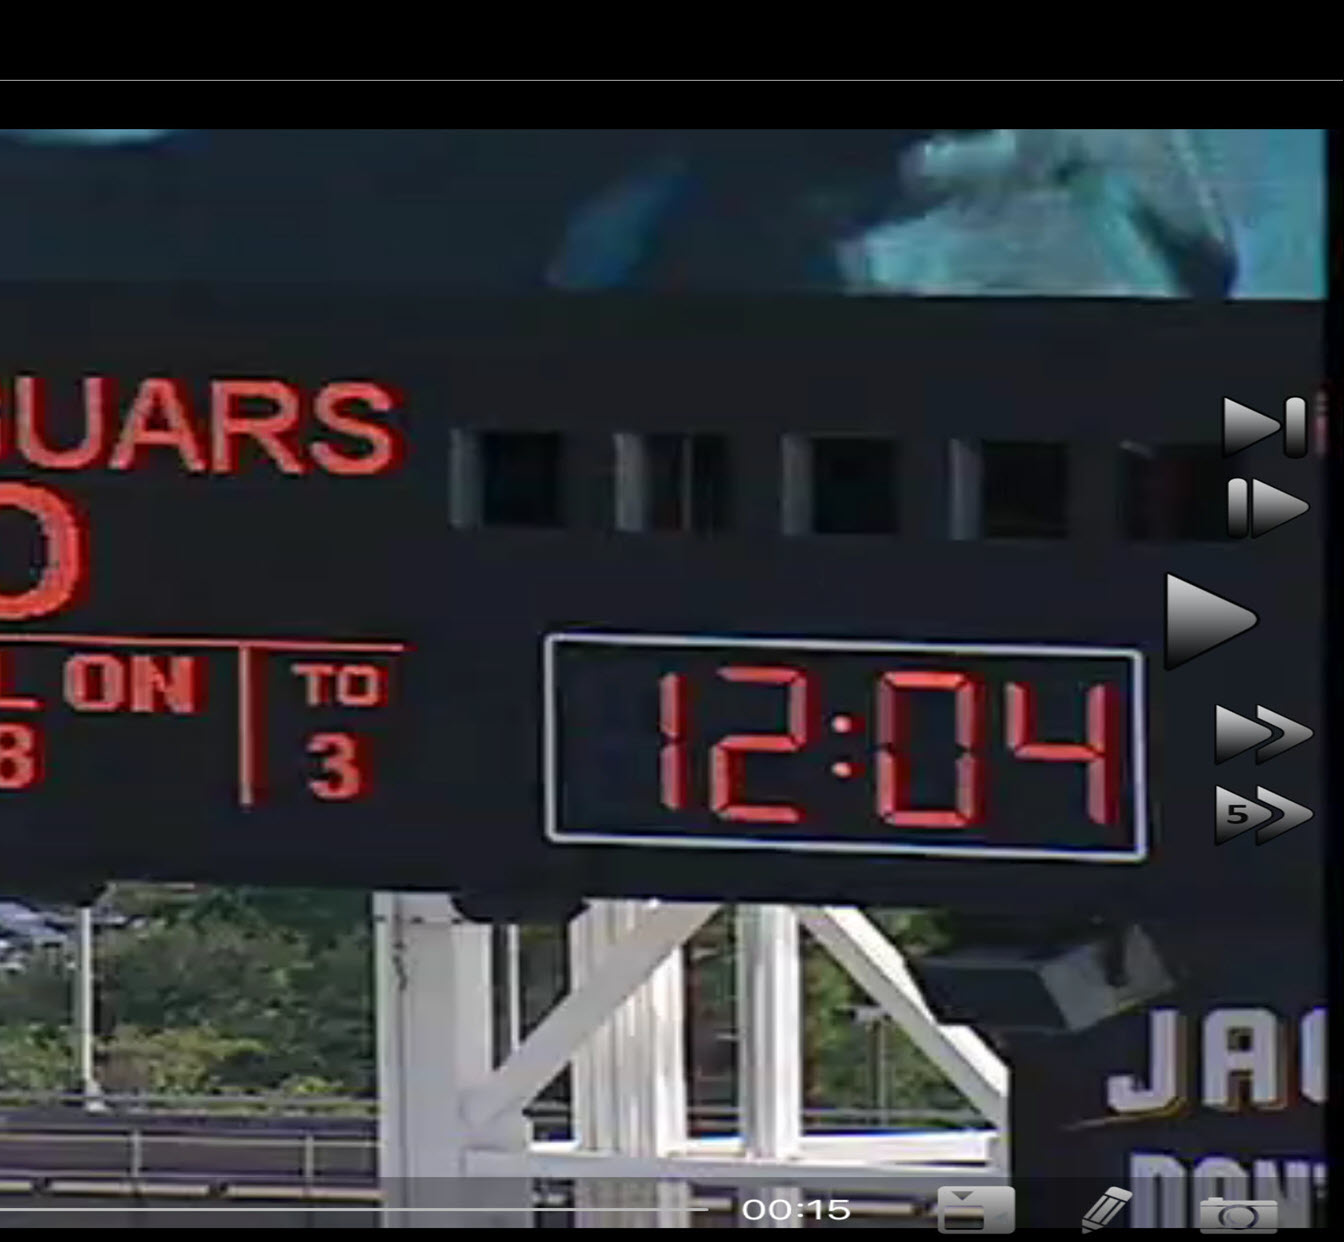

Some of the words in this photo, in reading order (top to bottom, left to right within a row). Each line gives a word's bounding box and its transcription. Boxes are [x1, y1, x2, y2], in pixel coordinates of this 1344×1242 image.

[64, 653, 197, 715] ON
[291, 663, 387, 707] TO
[307, 732, 361, 800] 3
[659, 666, 1111, 826] 12:04
